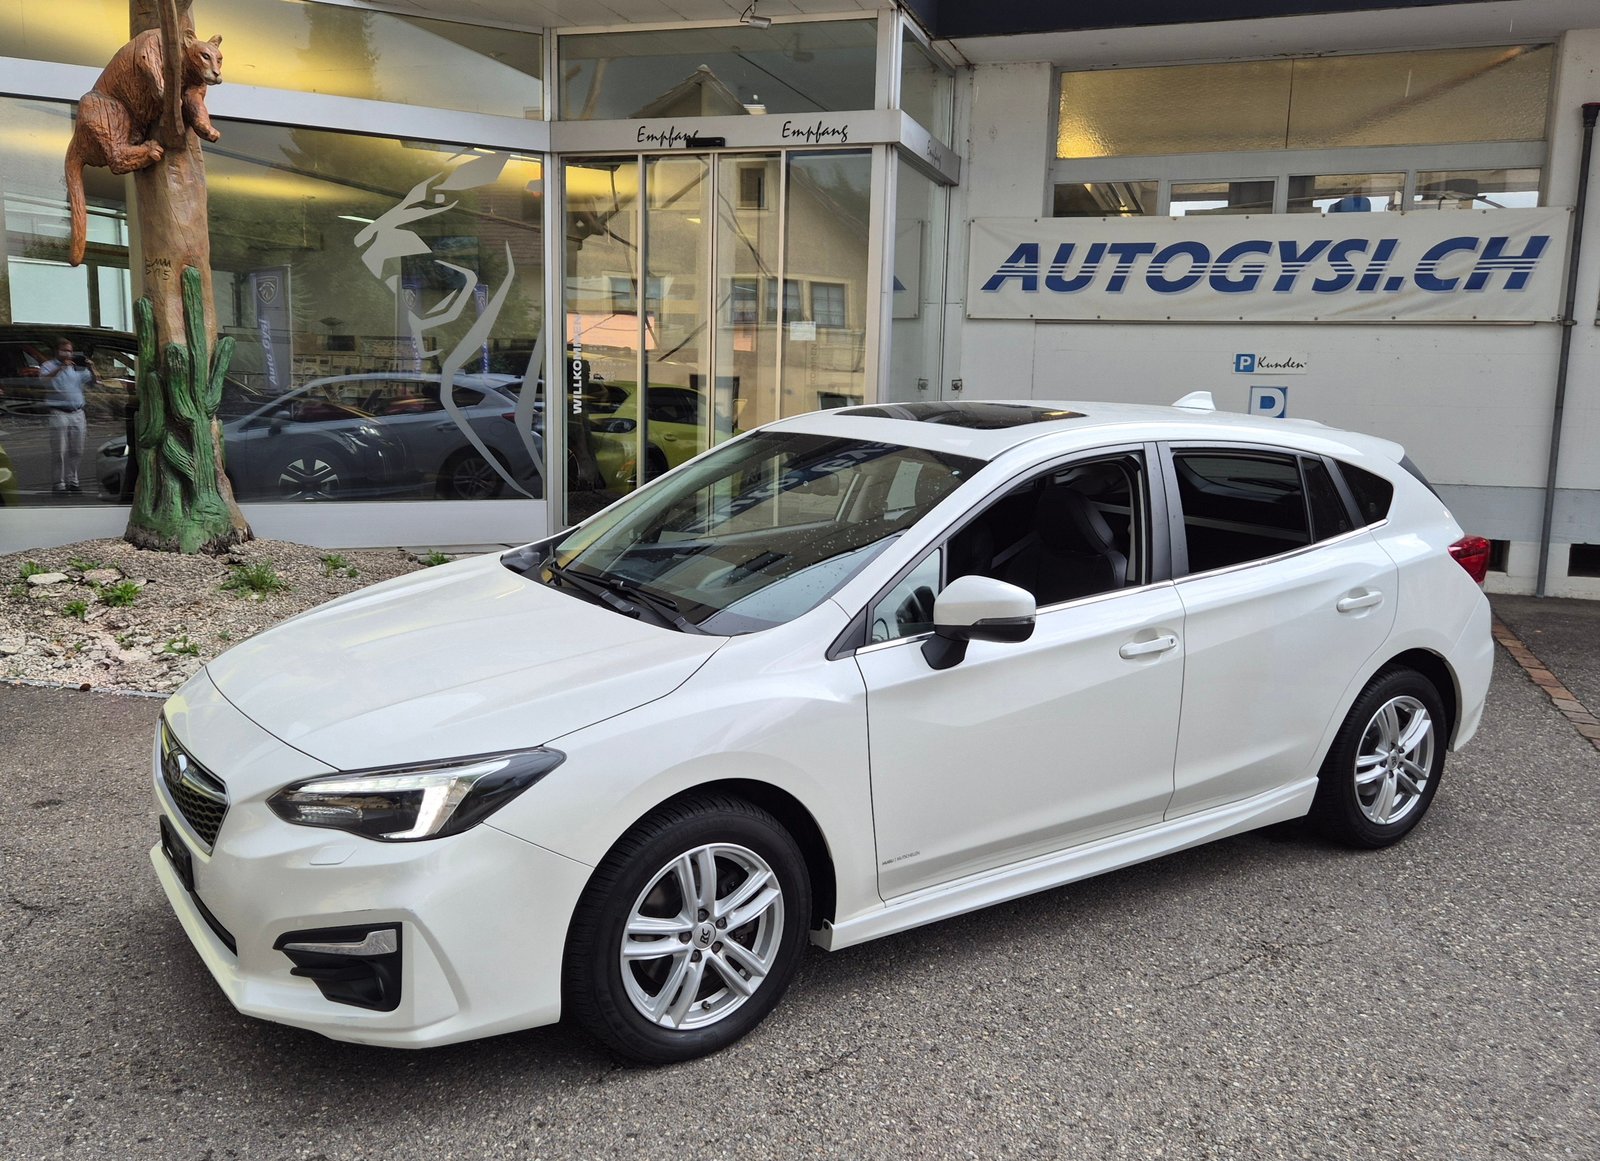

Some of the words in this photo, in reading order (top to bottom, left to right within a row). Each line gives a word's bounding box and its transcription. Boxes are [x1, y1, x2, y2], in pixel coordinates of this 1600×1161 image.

[782, 120, 848, 143] Empfang
[980, 235, 1552, 294] AUTOGYSI.CH
[1240, 356, 1251, 370] P
[1257, 356, 1304, 368] Kunden
